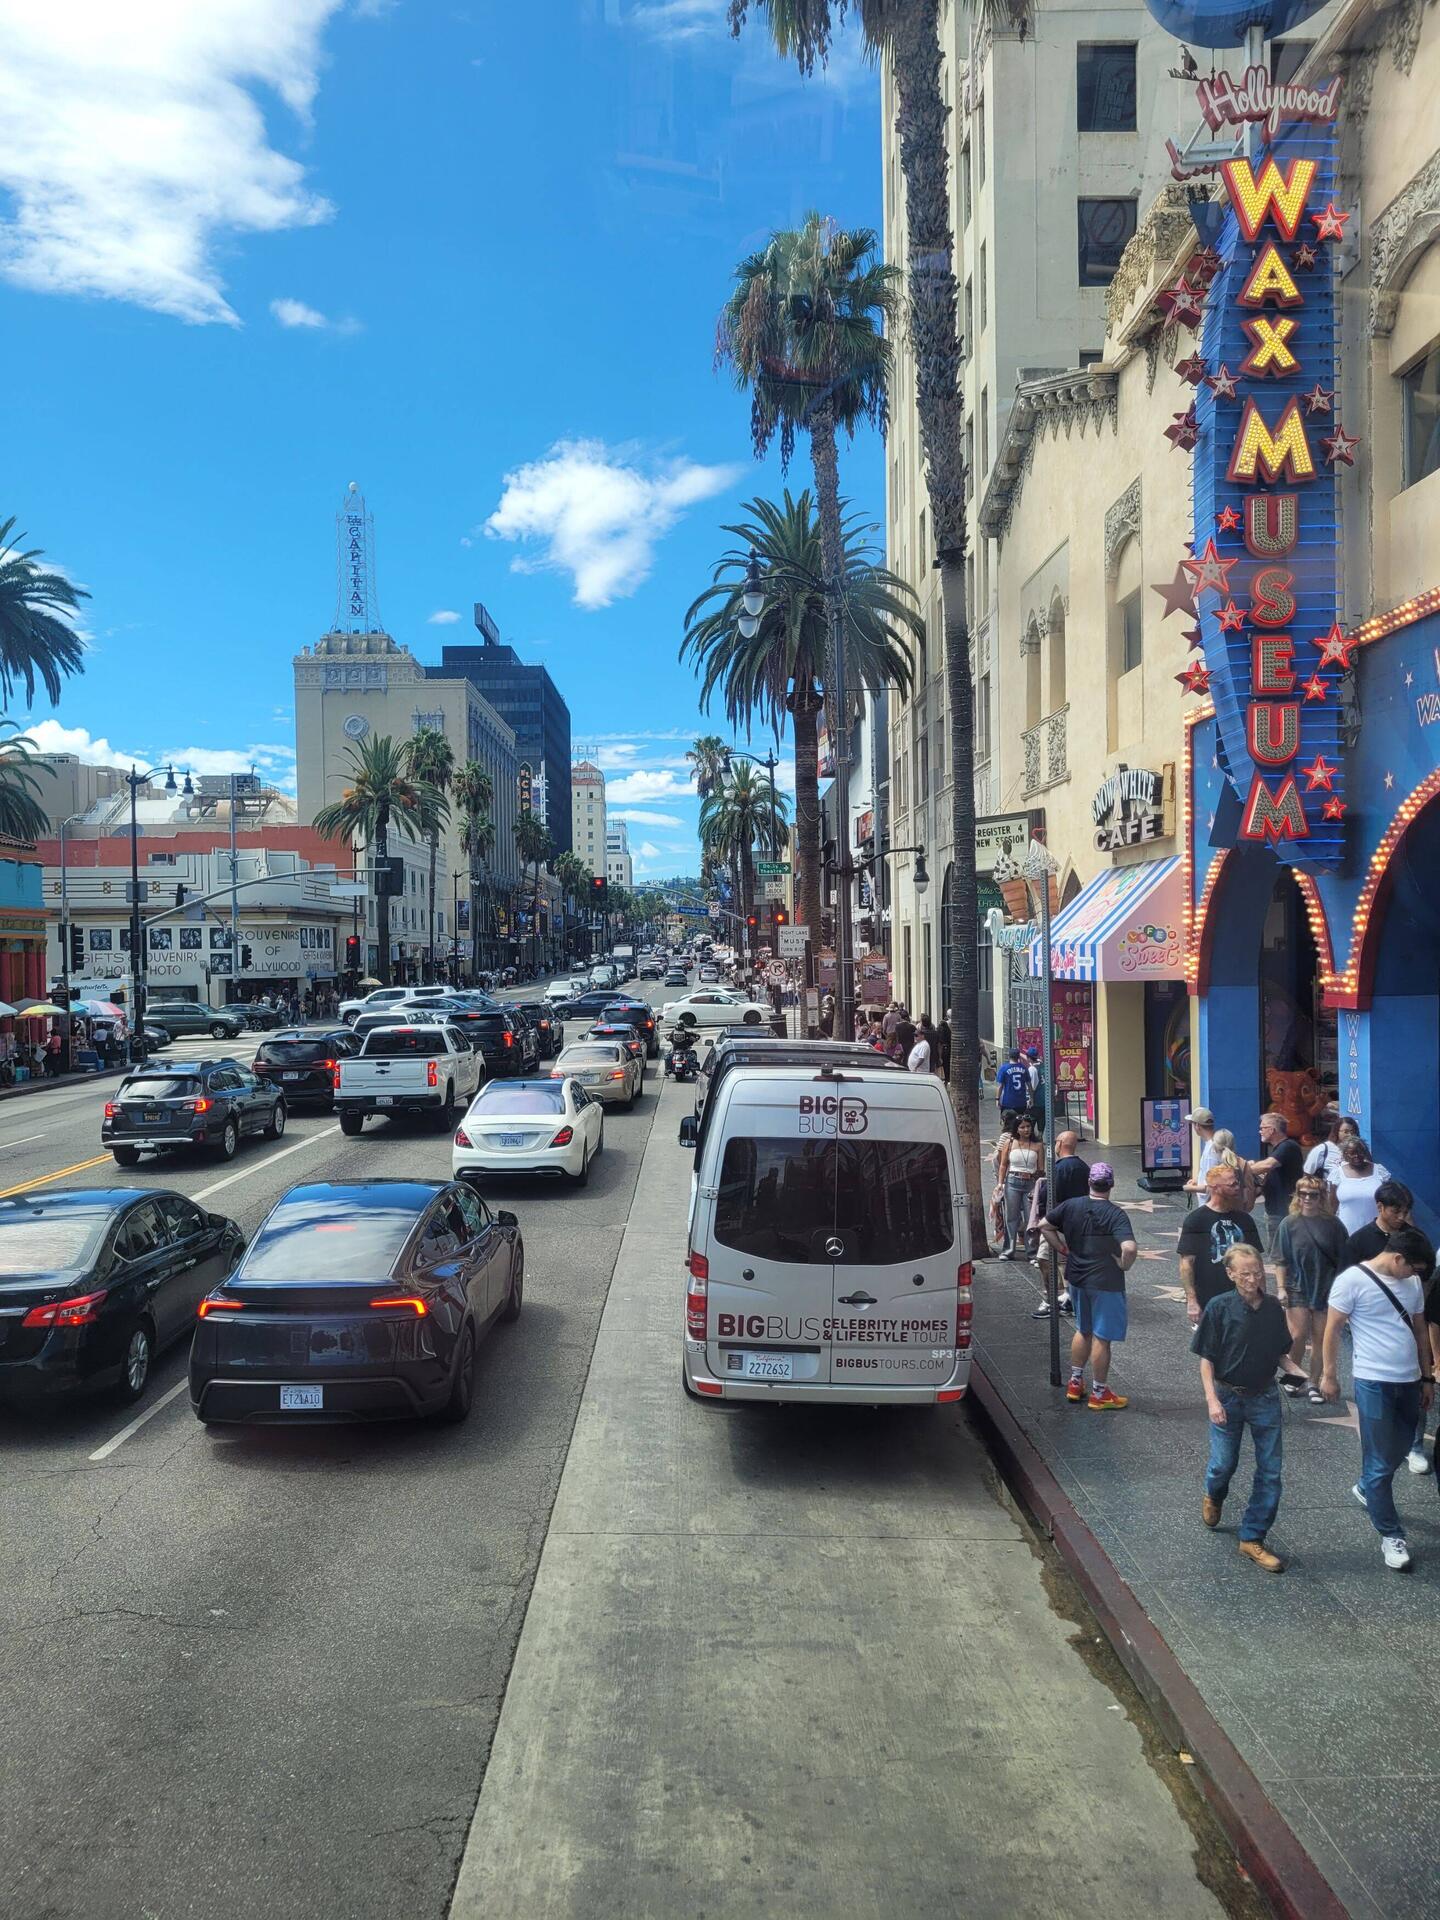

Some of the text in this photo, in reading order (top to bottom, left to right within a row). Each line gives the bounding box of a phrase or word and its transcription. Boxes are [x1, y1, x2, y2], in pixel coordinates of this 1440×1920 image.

[1197, 65, 1342, 146] Hollywood
[1222, 156, 1320, 841] WAX MUSEUM
[1120, 768, 1154, 806] WHITE
[976, 823, 1023, 838] REGISTER 4
[1093, 814, 1155, 851] CAFE
[975, 838, 991, 848] NEW
[236, 930, 300, 941] SOUVENIRS
[265, 946, 281, 956] OF
[1012, 1074, 1021, 1090] 5
[799, 1095, 837, 1115] BIG
[798, 1115, 837, 1135] BUS
[822, 1318, 948, 1332] CELEBRITY HOMES
[822, 1331, 948, 1344] & LIFESTYLE TOUR
[835, 1358, 945, 1371] BIGBUSTOURS.COM
